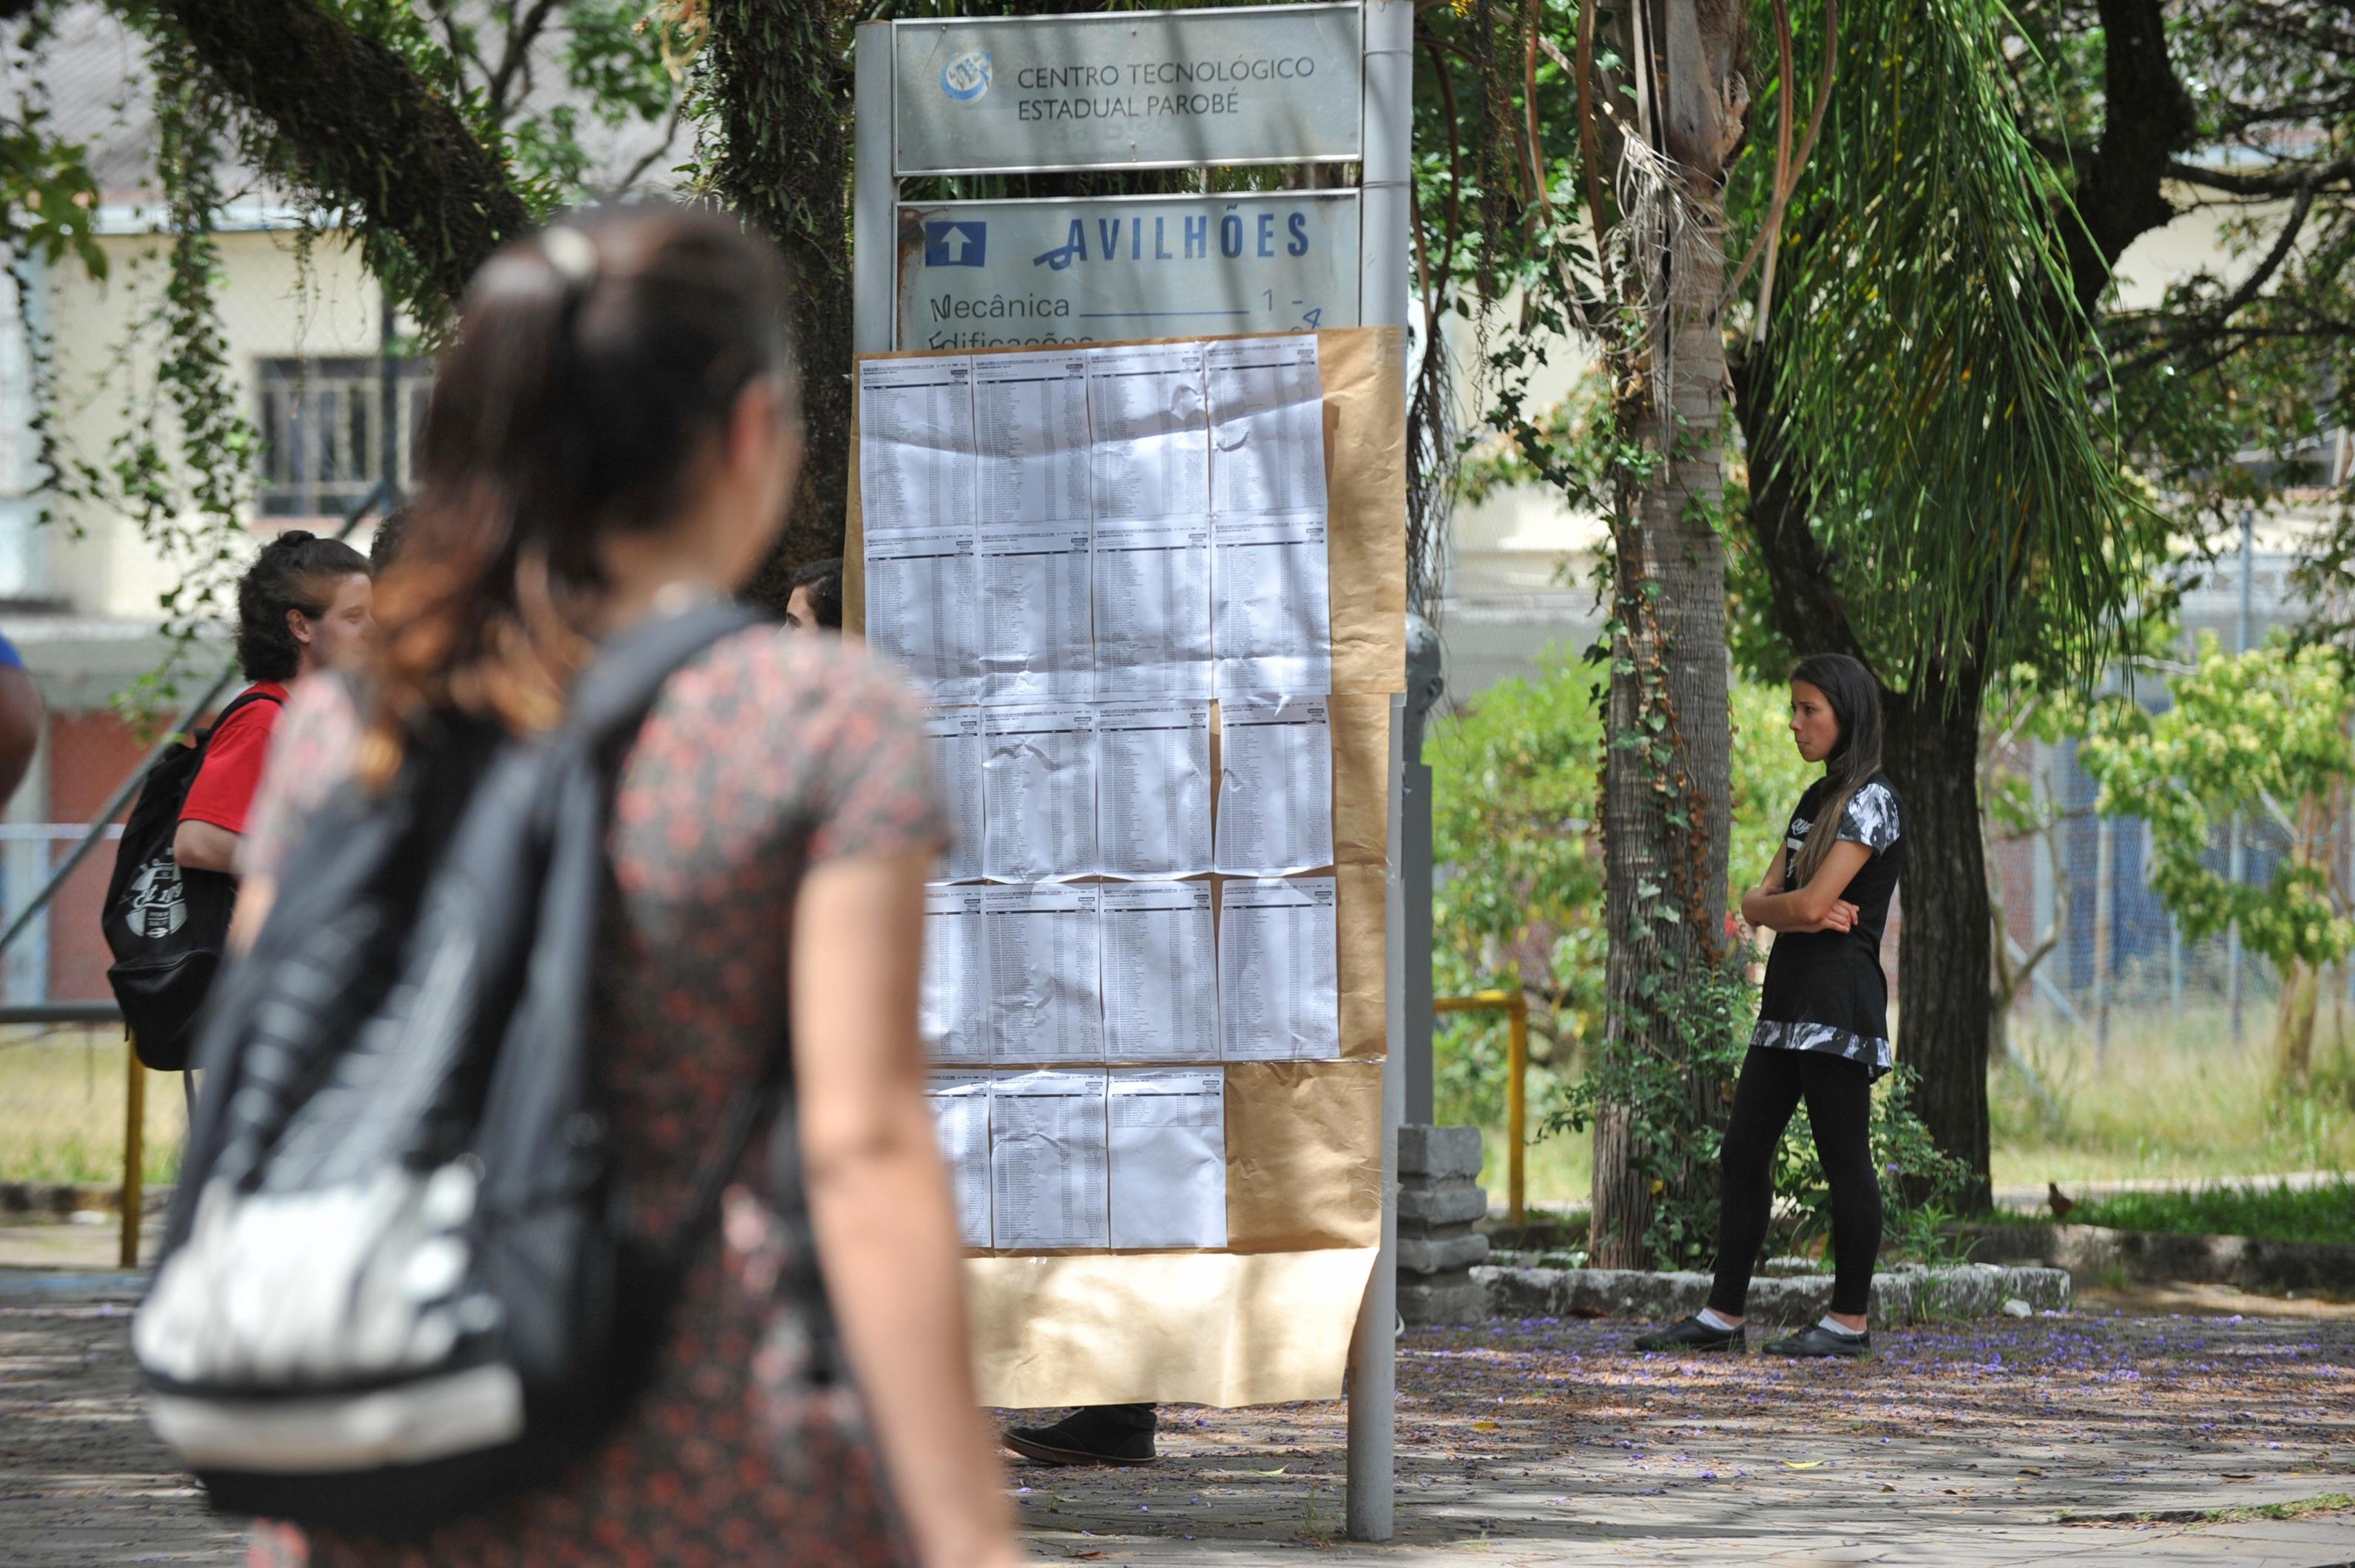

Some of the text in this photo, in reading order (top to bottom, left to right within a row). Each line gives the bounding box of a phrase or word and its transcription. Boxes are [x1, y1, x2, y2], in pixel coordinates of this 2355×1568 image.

[1017, 65, 1119, 89] CENTRO
[1127, 54, 1315, 84] TECNOLÓGICO
[1018, 87, 1239, 121] ESTADUAL PAROBÉ
